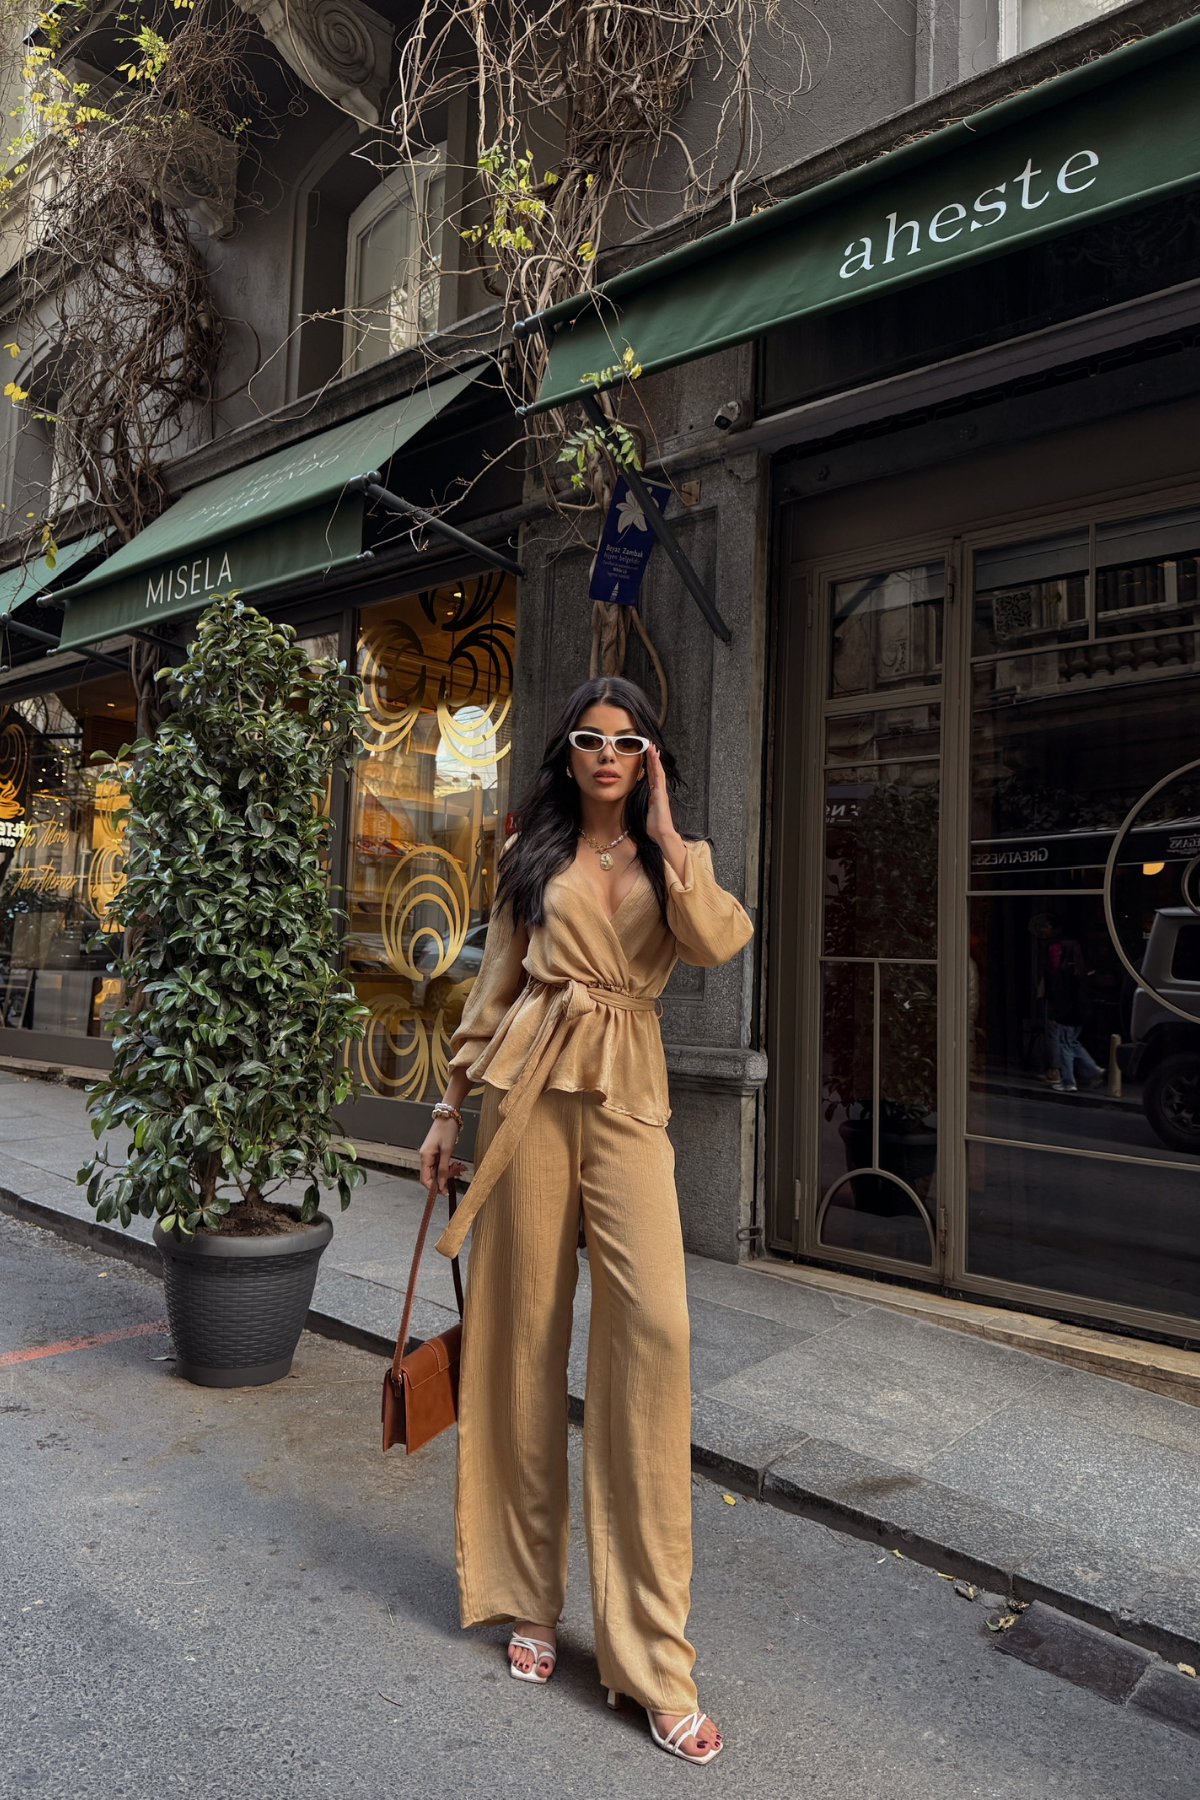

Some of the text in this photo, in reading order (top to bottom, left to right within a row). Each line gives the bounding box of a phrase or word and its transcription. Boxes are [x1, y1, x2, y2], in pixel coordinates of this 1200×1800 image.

[838, 150, 1100, 279] aheste
[622, 547, 643, 558] Zambak
[145, 551, 233, 609] MISELA
[13, 819, 40, 853] The
[11, 861, 37, 896] The
